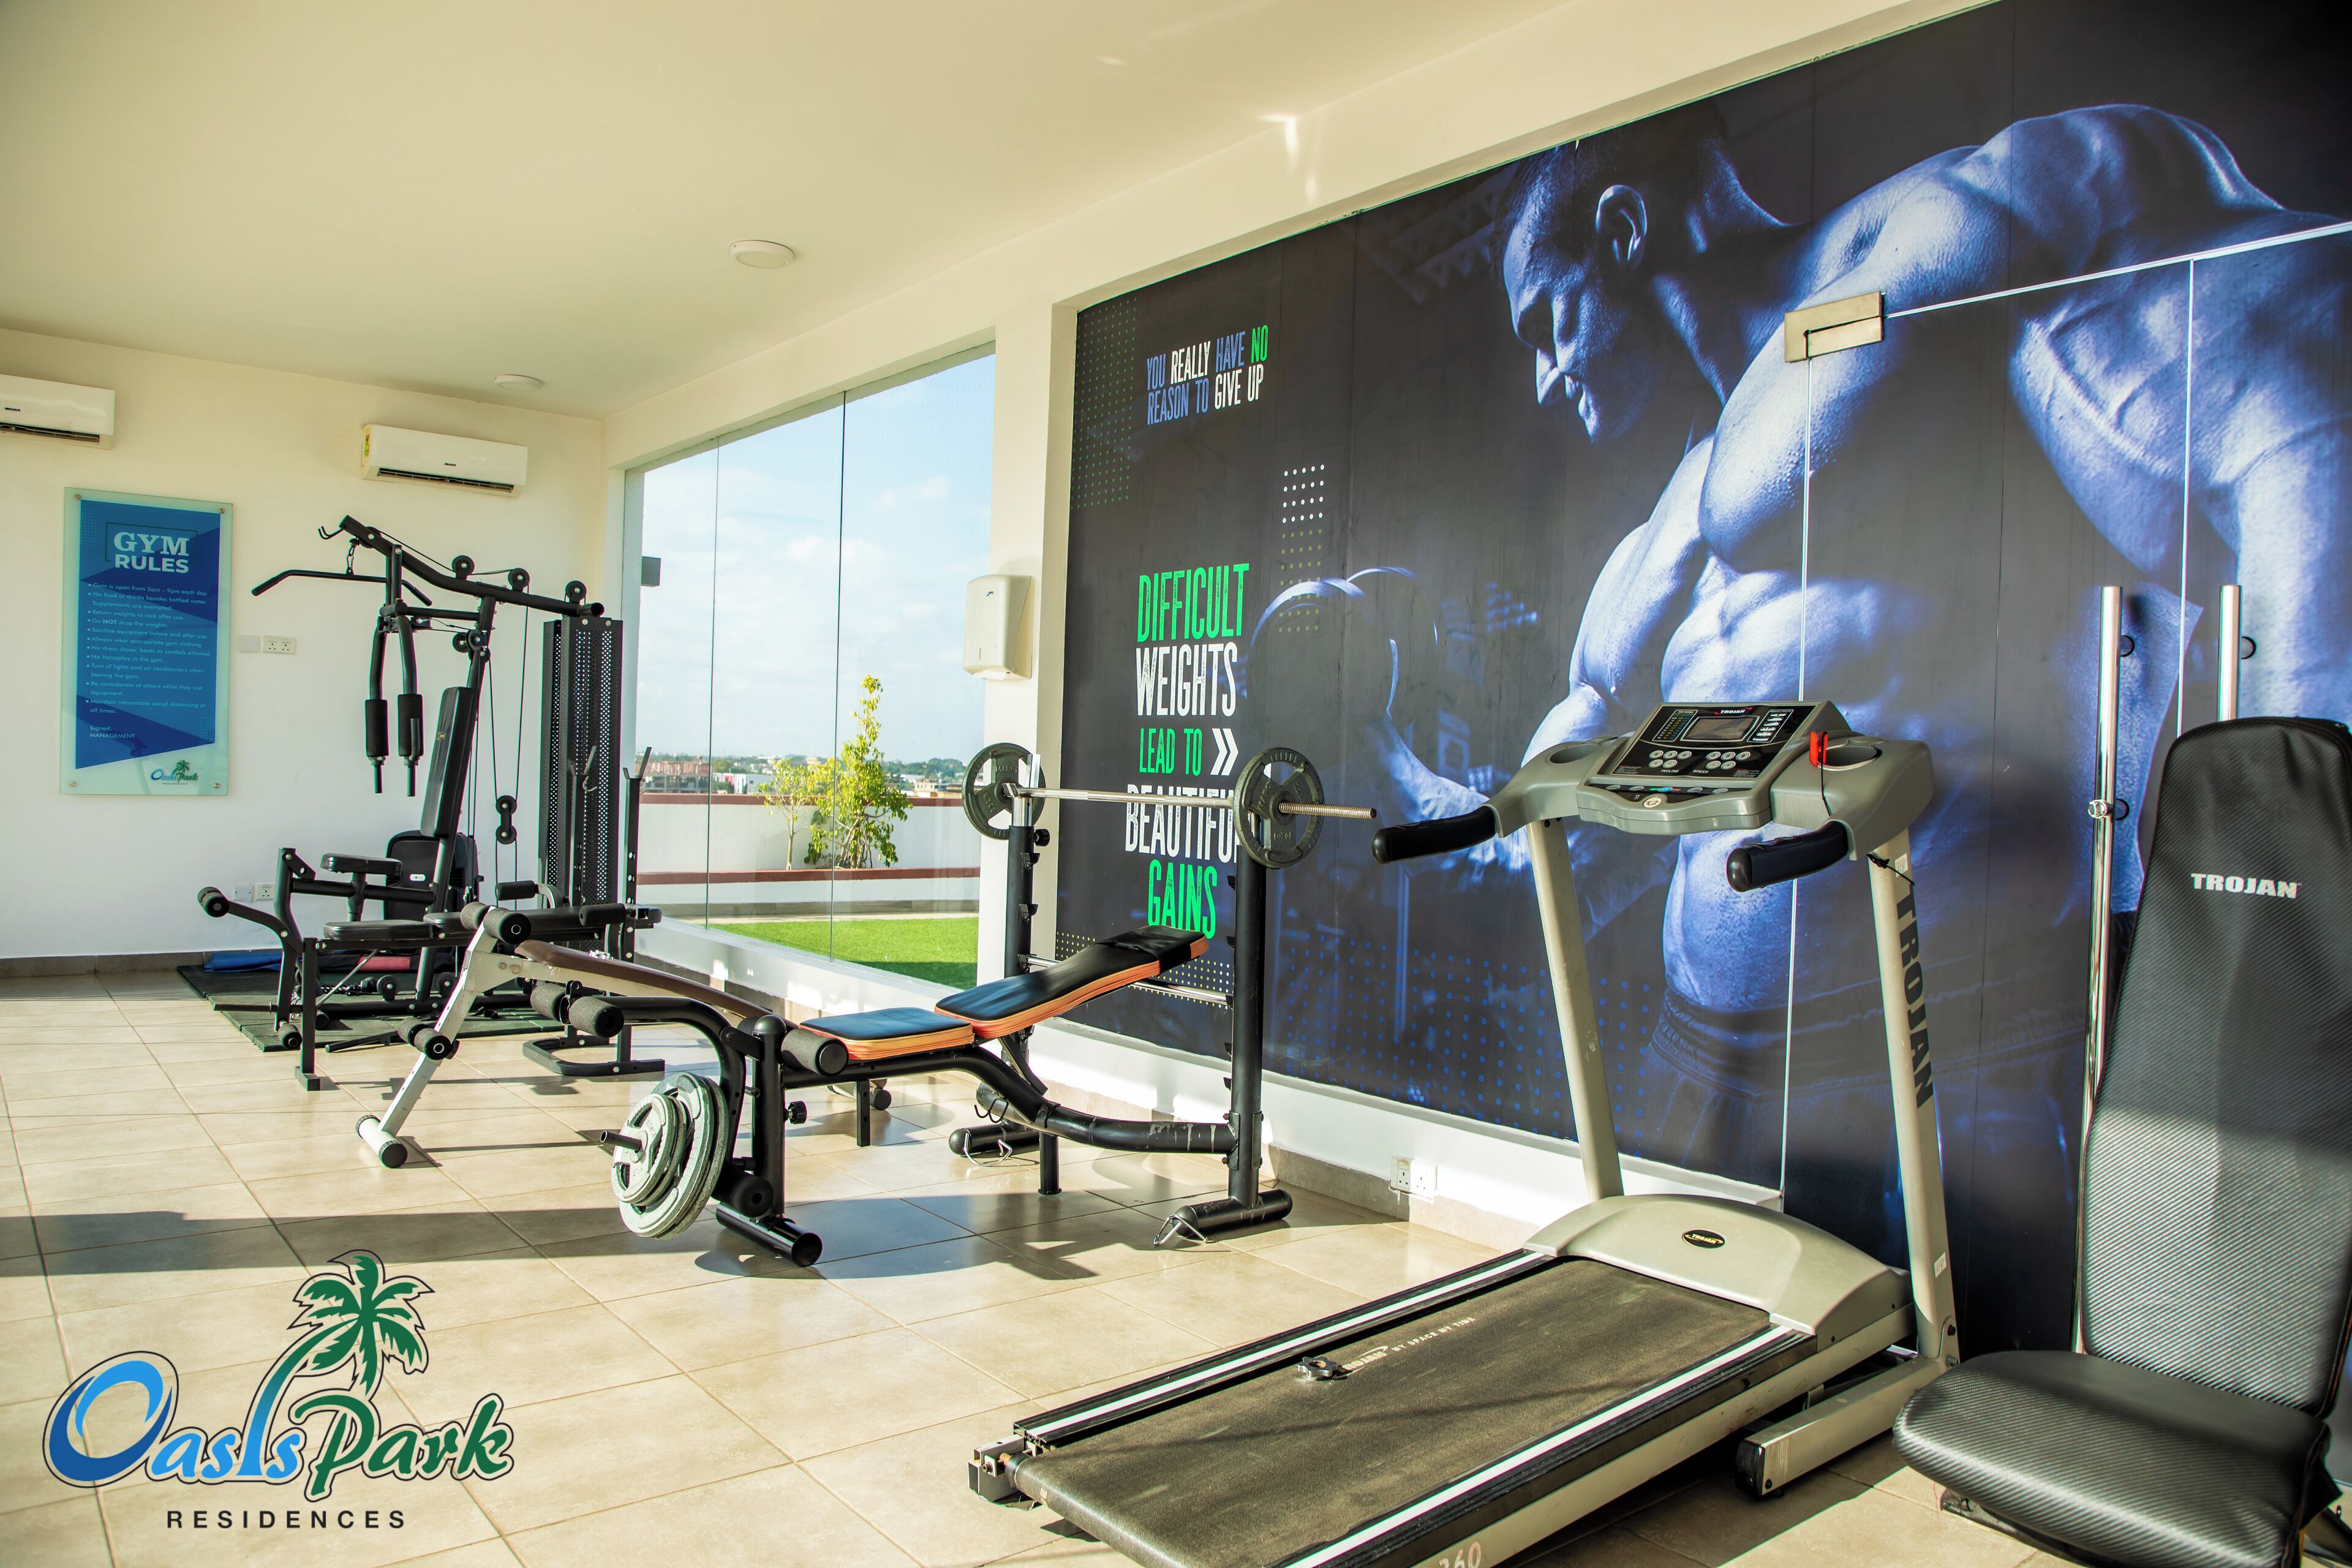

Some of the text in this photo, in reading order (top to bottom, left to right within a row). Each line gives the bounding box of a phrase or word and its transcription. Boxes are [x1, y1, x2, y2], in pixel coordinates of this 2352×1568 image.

[1146, 325, 1269, 391] YOU REALLY HAVE NO
[1147, 363, 1264, 426] REASON TO GIVE UP
[113, 531, 190, 556] GYM
[115, 553, 189, 573] RULES
[1137, 563, 1250, 643] DIFFICULT
[1136, 641, 1237, 717] WEIGHTS
[1139, 728, 1202, 776] LEAD TO
[176, 772, 198, 782] Park
[1147, 859, 1218, 939] GAINS
[2191, 873, 2298, 899] TROJAN
[1896, 883, 1934, 1109] TROJAN
[1691, 1233, 1717, 1245] TROJAN
[1407, 1332, 1439, 1346] SPACE
[1452, 1317, 1476, 1327] TIME
